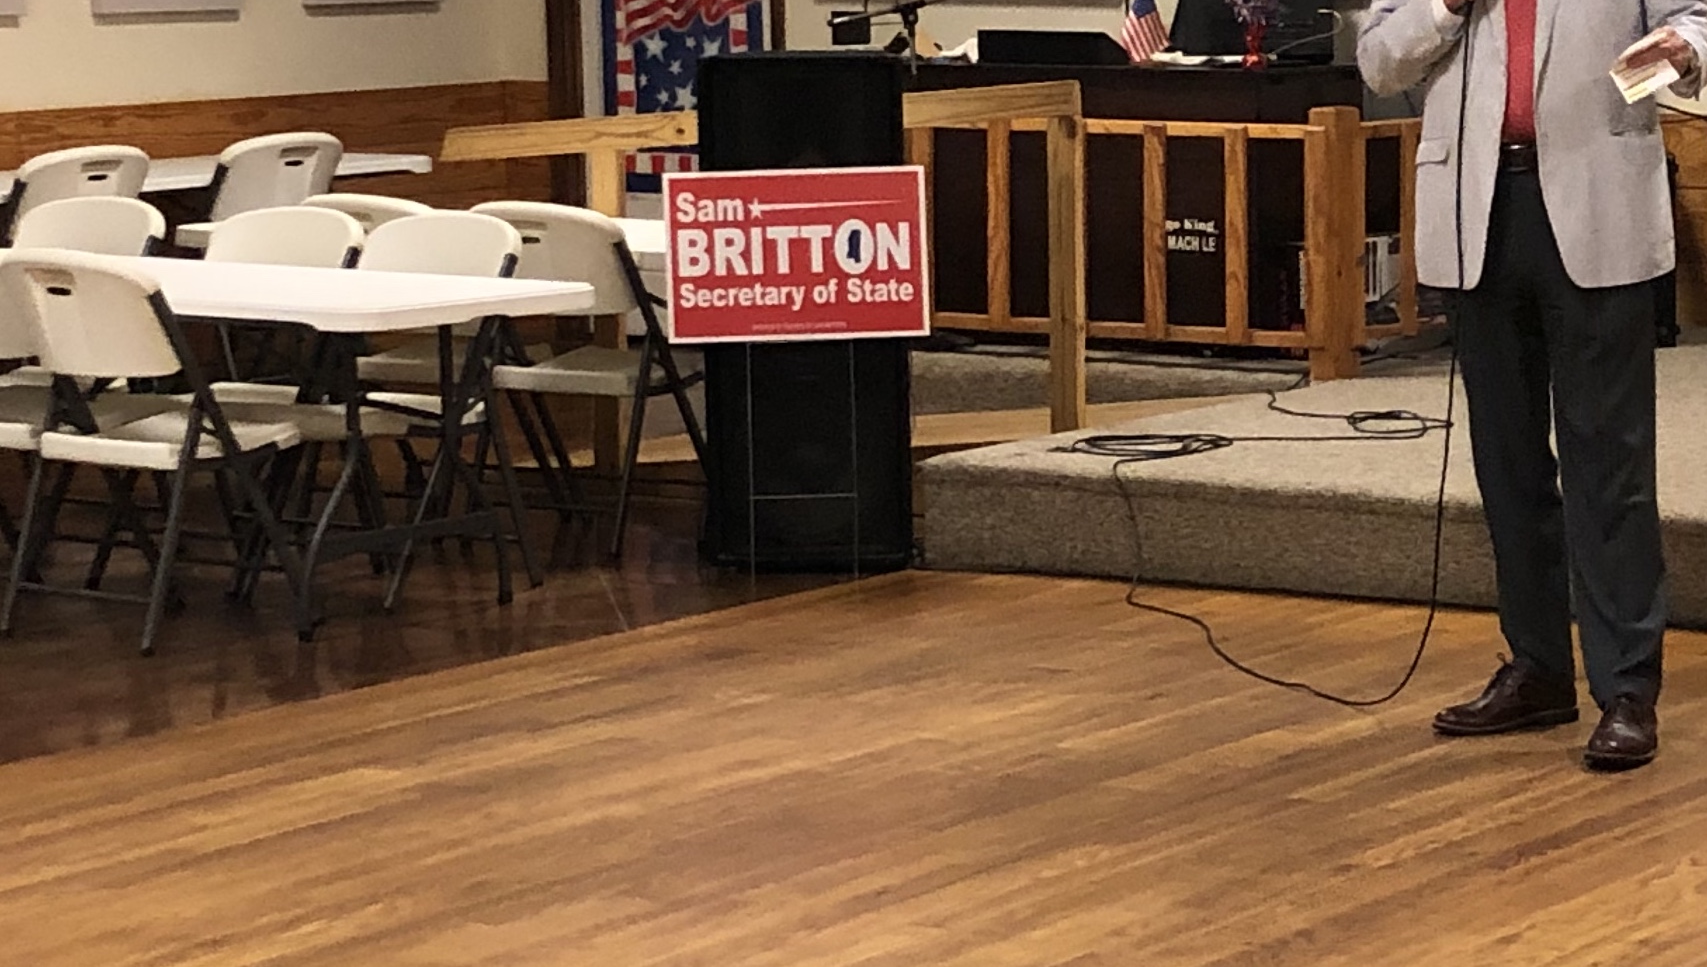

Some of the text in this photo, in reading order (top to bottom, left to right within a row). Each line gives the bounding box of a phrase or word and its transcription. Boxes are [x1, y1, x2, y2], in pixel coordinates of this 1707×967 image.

[676, 192, 745, 223] Sam
[677, 219, 911, 277] BRITTON
[679, 278, 914, 311] Secretary of State
